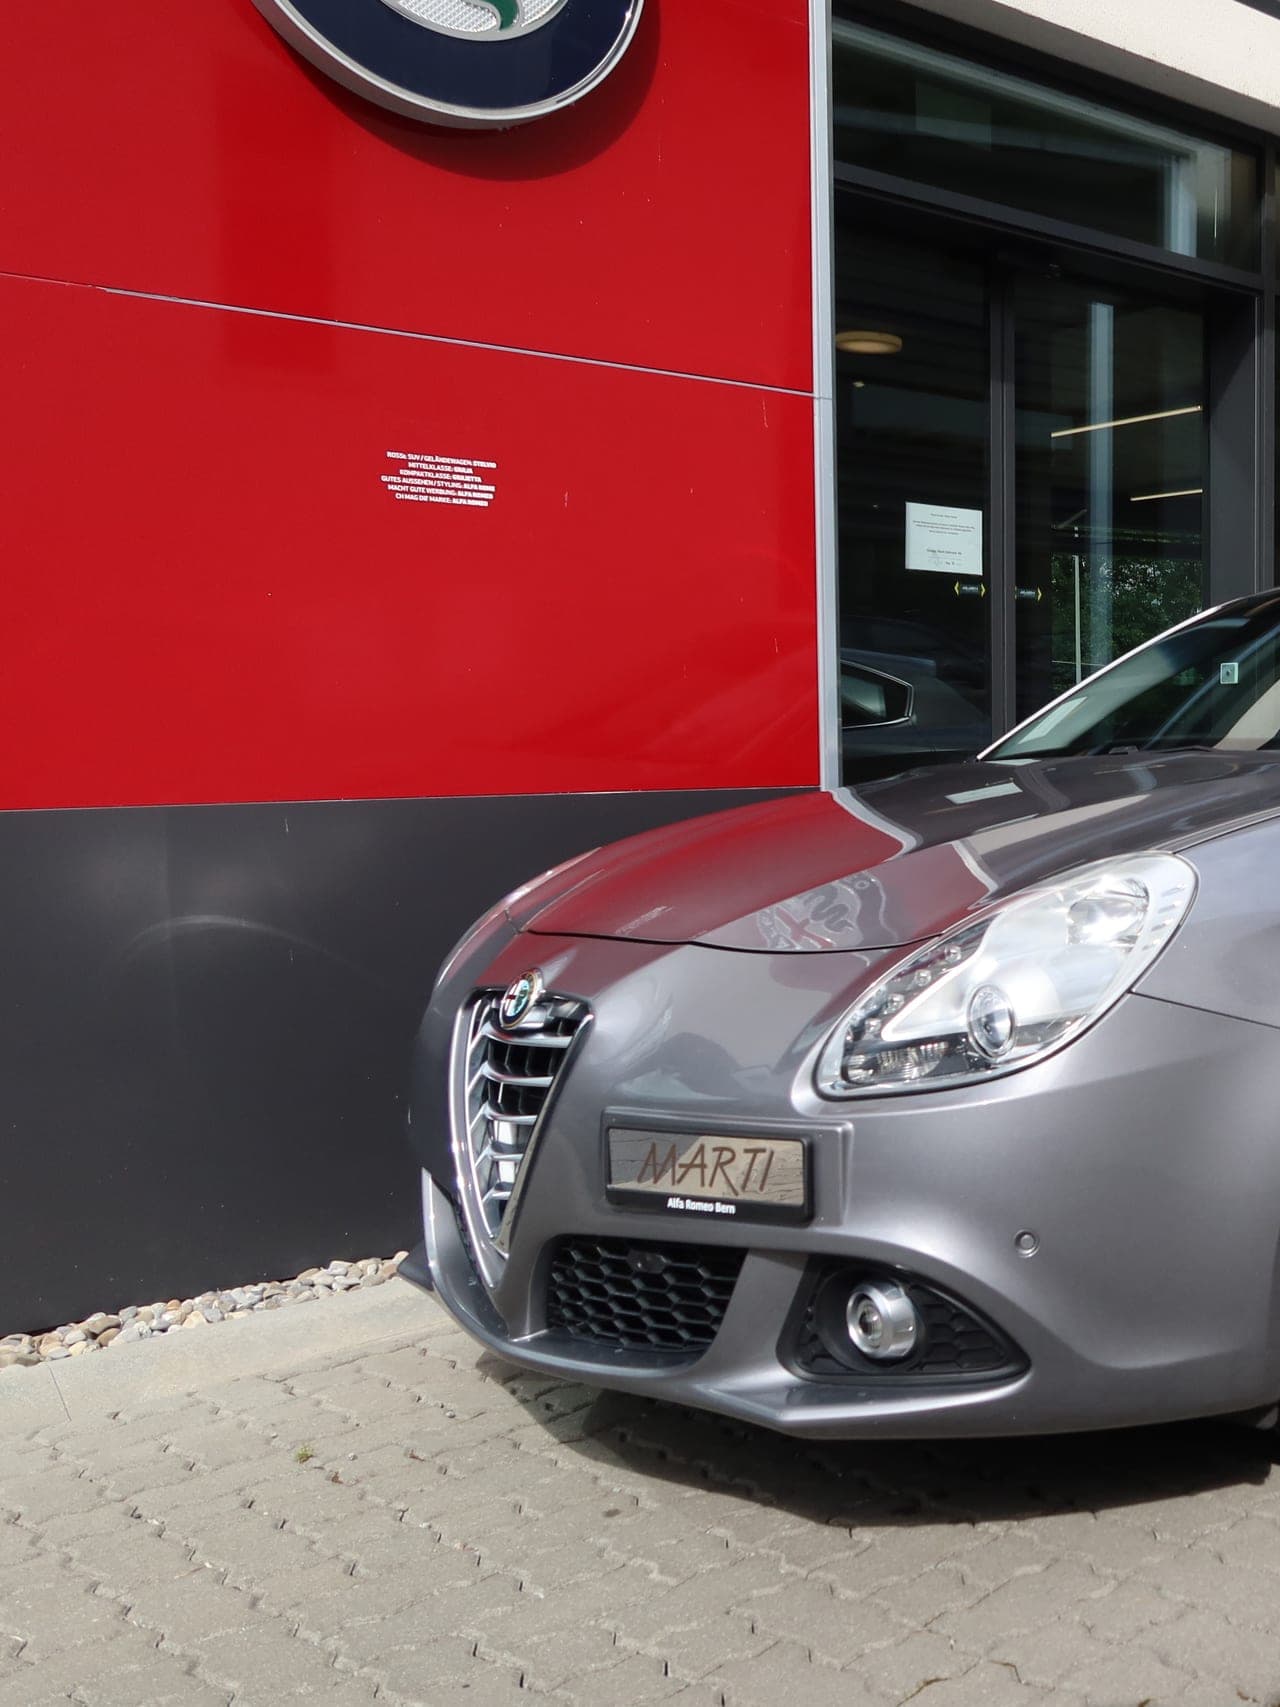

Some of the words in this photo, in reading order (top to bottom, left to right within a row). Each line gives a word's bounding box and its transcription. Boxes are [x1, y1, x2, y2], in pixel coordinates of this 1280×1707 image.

[381, 475, 401, 483] GUTES
[636, 1141, 775, 1196] MARTI
[667, 1197, 684, 1209] Alfa
[685, 1199, 714, 1212] Romeo
[715, 1201, 736, 1215] Bern
